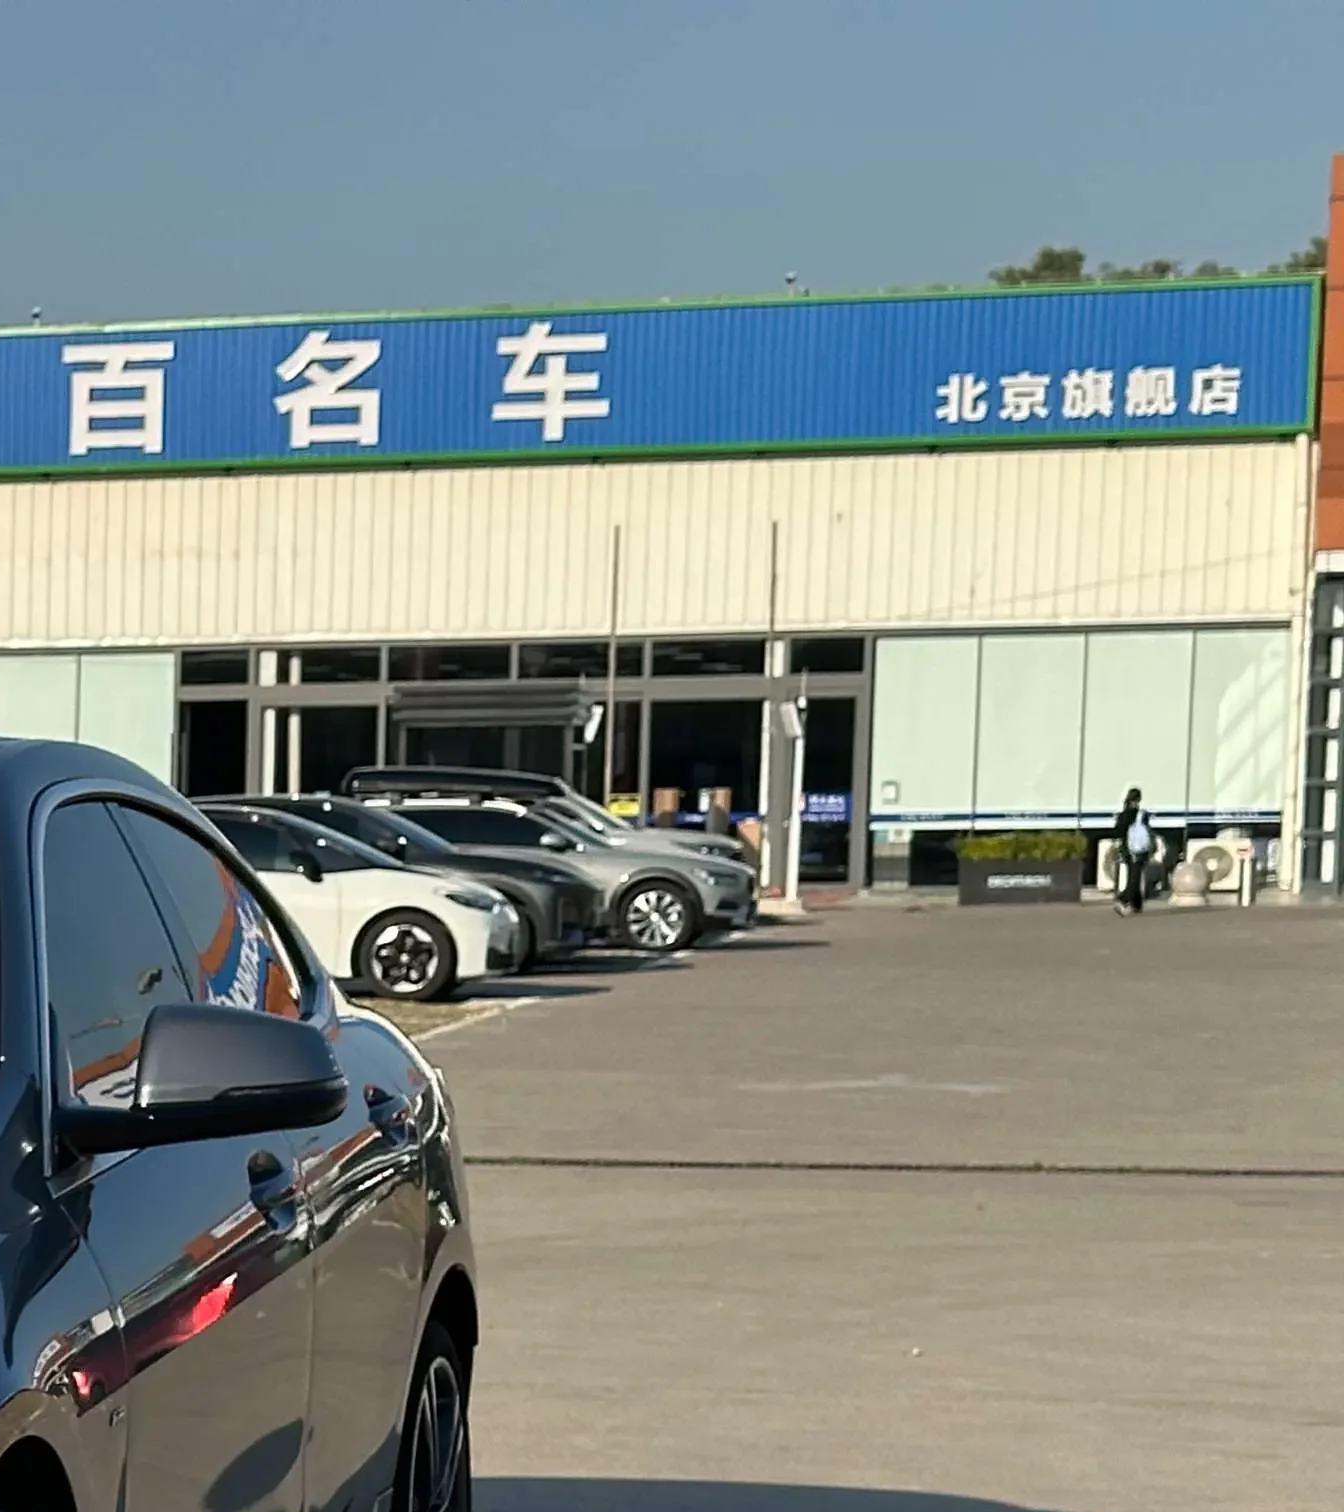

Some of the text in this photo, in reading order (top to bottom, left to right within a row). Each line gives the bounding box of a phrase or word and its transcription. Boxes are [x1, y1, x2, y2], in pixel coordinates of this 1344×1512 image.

[936, 365, 1242, 423] 北京旗舰店
